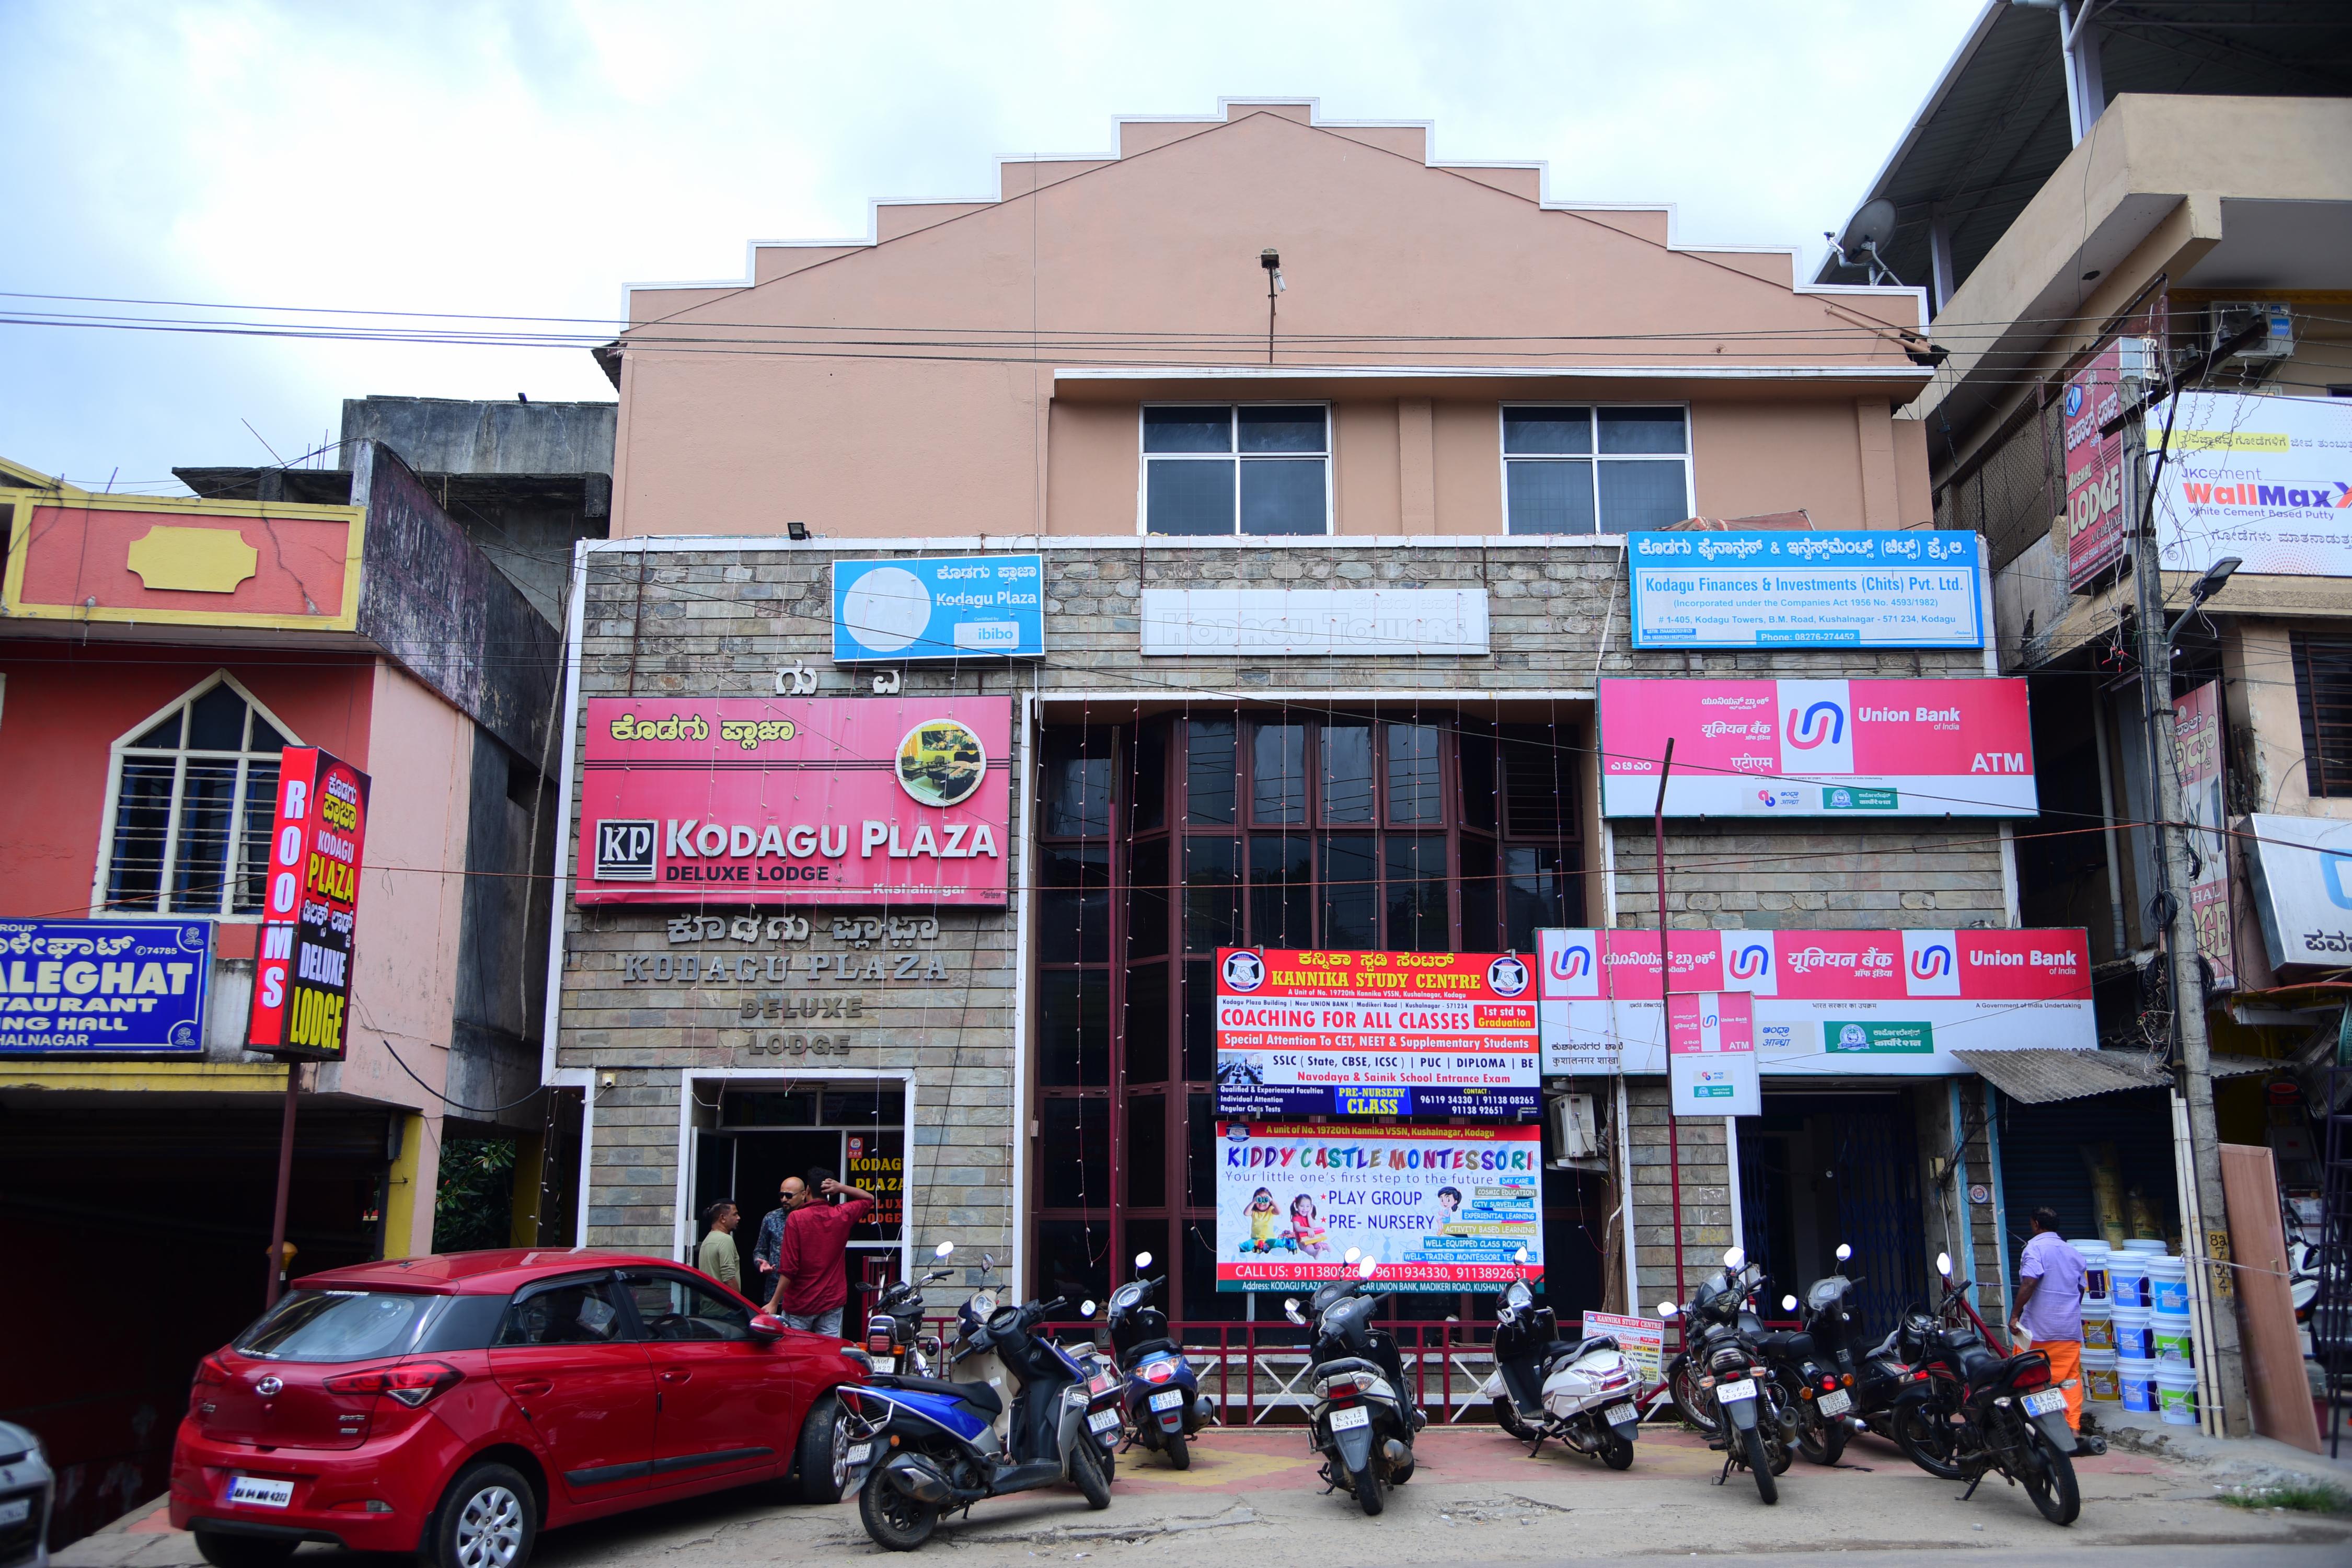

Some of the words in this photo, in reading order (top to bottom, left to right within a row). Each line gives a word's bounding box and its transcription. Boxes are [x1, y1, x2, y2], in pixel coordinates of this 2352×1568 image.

[2070, 464, 2119, 539] LODGE
[2188, 506, 2220, 516] White
[2224, 509, 2265, 517] Cement
[2269, 510, 2302, 518] Based
[2306, 511, 2334, 521] Putty
[1638, 538, 1692, 556] ಕೊಡಗು
[936, 564, 990, 580] ಕೊಡಗು
[997, 565, 1037, 582] ಪ್ಲಾಜಾ
[1646, 578, 1694, 594] Kodagu
[1699, 577, 1758, 591] Finances
[1776, 577, 1857, 591] Investments
[1862, 577, 1904, 593] (Chits)
[1909, 577, 1934, 591] Pvt.
[1939, 577, 1963, 591] Ltd.
[936, 592, 993, 608] Kodagu
[997, 591, 1037, 605] Plaza
[1674, 599, 1733, 608] (Incorporated
[1781, 599, 1829, 608] Companies
[1891, 599, 1938, 607] 4593/1982)
[1761, 633, 1792, 641] Phone:
[1795, 632, 1854, 641] 08276-274452
[1858, 707, 1909, 722] Union
[1916, 707, 1961, 722] Bank
[610, 713, 710, 741] ಕೊಡಗು
[721, 720, 795, 751] ಪ್ಲಾಜಾ
[1701, 721, 1748, 737] यूनियन
[1750, 720, 1771, 734] बैंक
[1730, 753, 1773, 772] एटीएम
[1970, 753, 2024, 773] ATM
[329, 771, 357, 805] ಕೊಡಗು
[317, 829, 355, 864] KODAGU
[602, 826, 651, 861] KP
[666, 819, 848, 858] KODAGU
[861, 819, 999, 858] PLAZA
[307, 852, 354, 903] PLAZA
[666, 866, 750, 881] DELUXE
[758, 865, 829, 881] LODGE
[262, 780, 307, 1008] ROOMS
[873, 883, 966, 897] Kushalnagar
[2192, 885, 2221, 904] HAL
[299, 941, 347, 987] DELUXE
[1788, 947, 1858, 973] यूनियन
[1862, 947, 1894, 967] बैंक
[1969, 949, 2024, 966] Union
[2030, 949, 2077, 966] Bank
[622, 954, 790, 982] KODAGU
[807, 953, 949, 980] PLAZA
[1853, 969, 1871, 977] ऑफ
[1872, 969, 1893, 978] इंडिया
[2049, 967, 2059, 975] of
[2060, 967, 2077, 975] India
[0, 961, 193, 995] LEGHAT
[1271, 971, 1350, 987] KANNIKA
[1356, 972, 1409, 988] STUDY
[1415, 973, 1481, 989] CENTRE
[741, 998, 863, 1018] DELUXE
[1483, 1007, 1497, 1016] 1st
[1500, 1007, 1514, 1017] std
[1517, 1008, 1526, 1016] to
[57, 1017, 129, 1031] HALL
[290, 986, 345, 1050] LODGE
[1221, 1009, 1316, 1028] COACHING
[1322, 1010, 1356, 1028] FOR
[1363, 1011, 1392, 1029] ALL
[1399, 1012, 1470, 1030] CLASSES
[1478, 1018, 1531, 1028] Graduation
[748, 1034, 851, 1055] LODGE
[1225, 1033, 1263, 1046] Special
[1266, 1034, 1316, 1046] Attention
[1319, 1035, 1331, 1046] To
[1334, 1035, 1355, 1047] CET,
[1359, 1036, 1385, 1047] NEET
[1400, 1036, 1480, 1050] Supplementary
[1484, 1037, 1529, 1049] Students
[1729, 1041, 1749, 1050] ATM
[1339, 1088, 1405, 1098] PRE-NURSERY
[1347, 1098, 1398, 1114] CLASS
[851, 1158, 904, 1171] KODAG
[1227, 1145, 1297, 1169] KIDDY
[1300, 1146, 1382, 1169] CASTLE
[1388, 1147, 1534, 1171] MONTESSORI
[1329, 1190, 1366, 1205] PLAY
[1371, 1191, 1422, 1205] GROUP
[1329, 1214, 1362, 1229] PRE-
[1368, 1214, 1435, 1229] NURSERY
[1597, 1315, 1621, 1324] KANNIKA
[1622, 1318, 1640, 1327] STUDY
[1640, 1320, 1662, 1330] CENTRE
[1618, 1332, 1640, 1342] Classes
[2033, 1394, 2045, 1405] KA
[2046, 1391, 2056, 1400] 45
